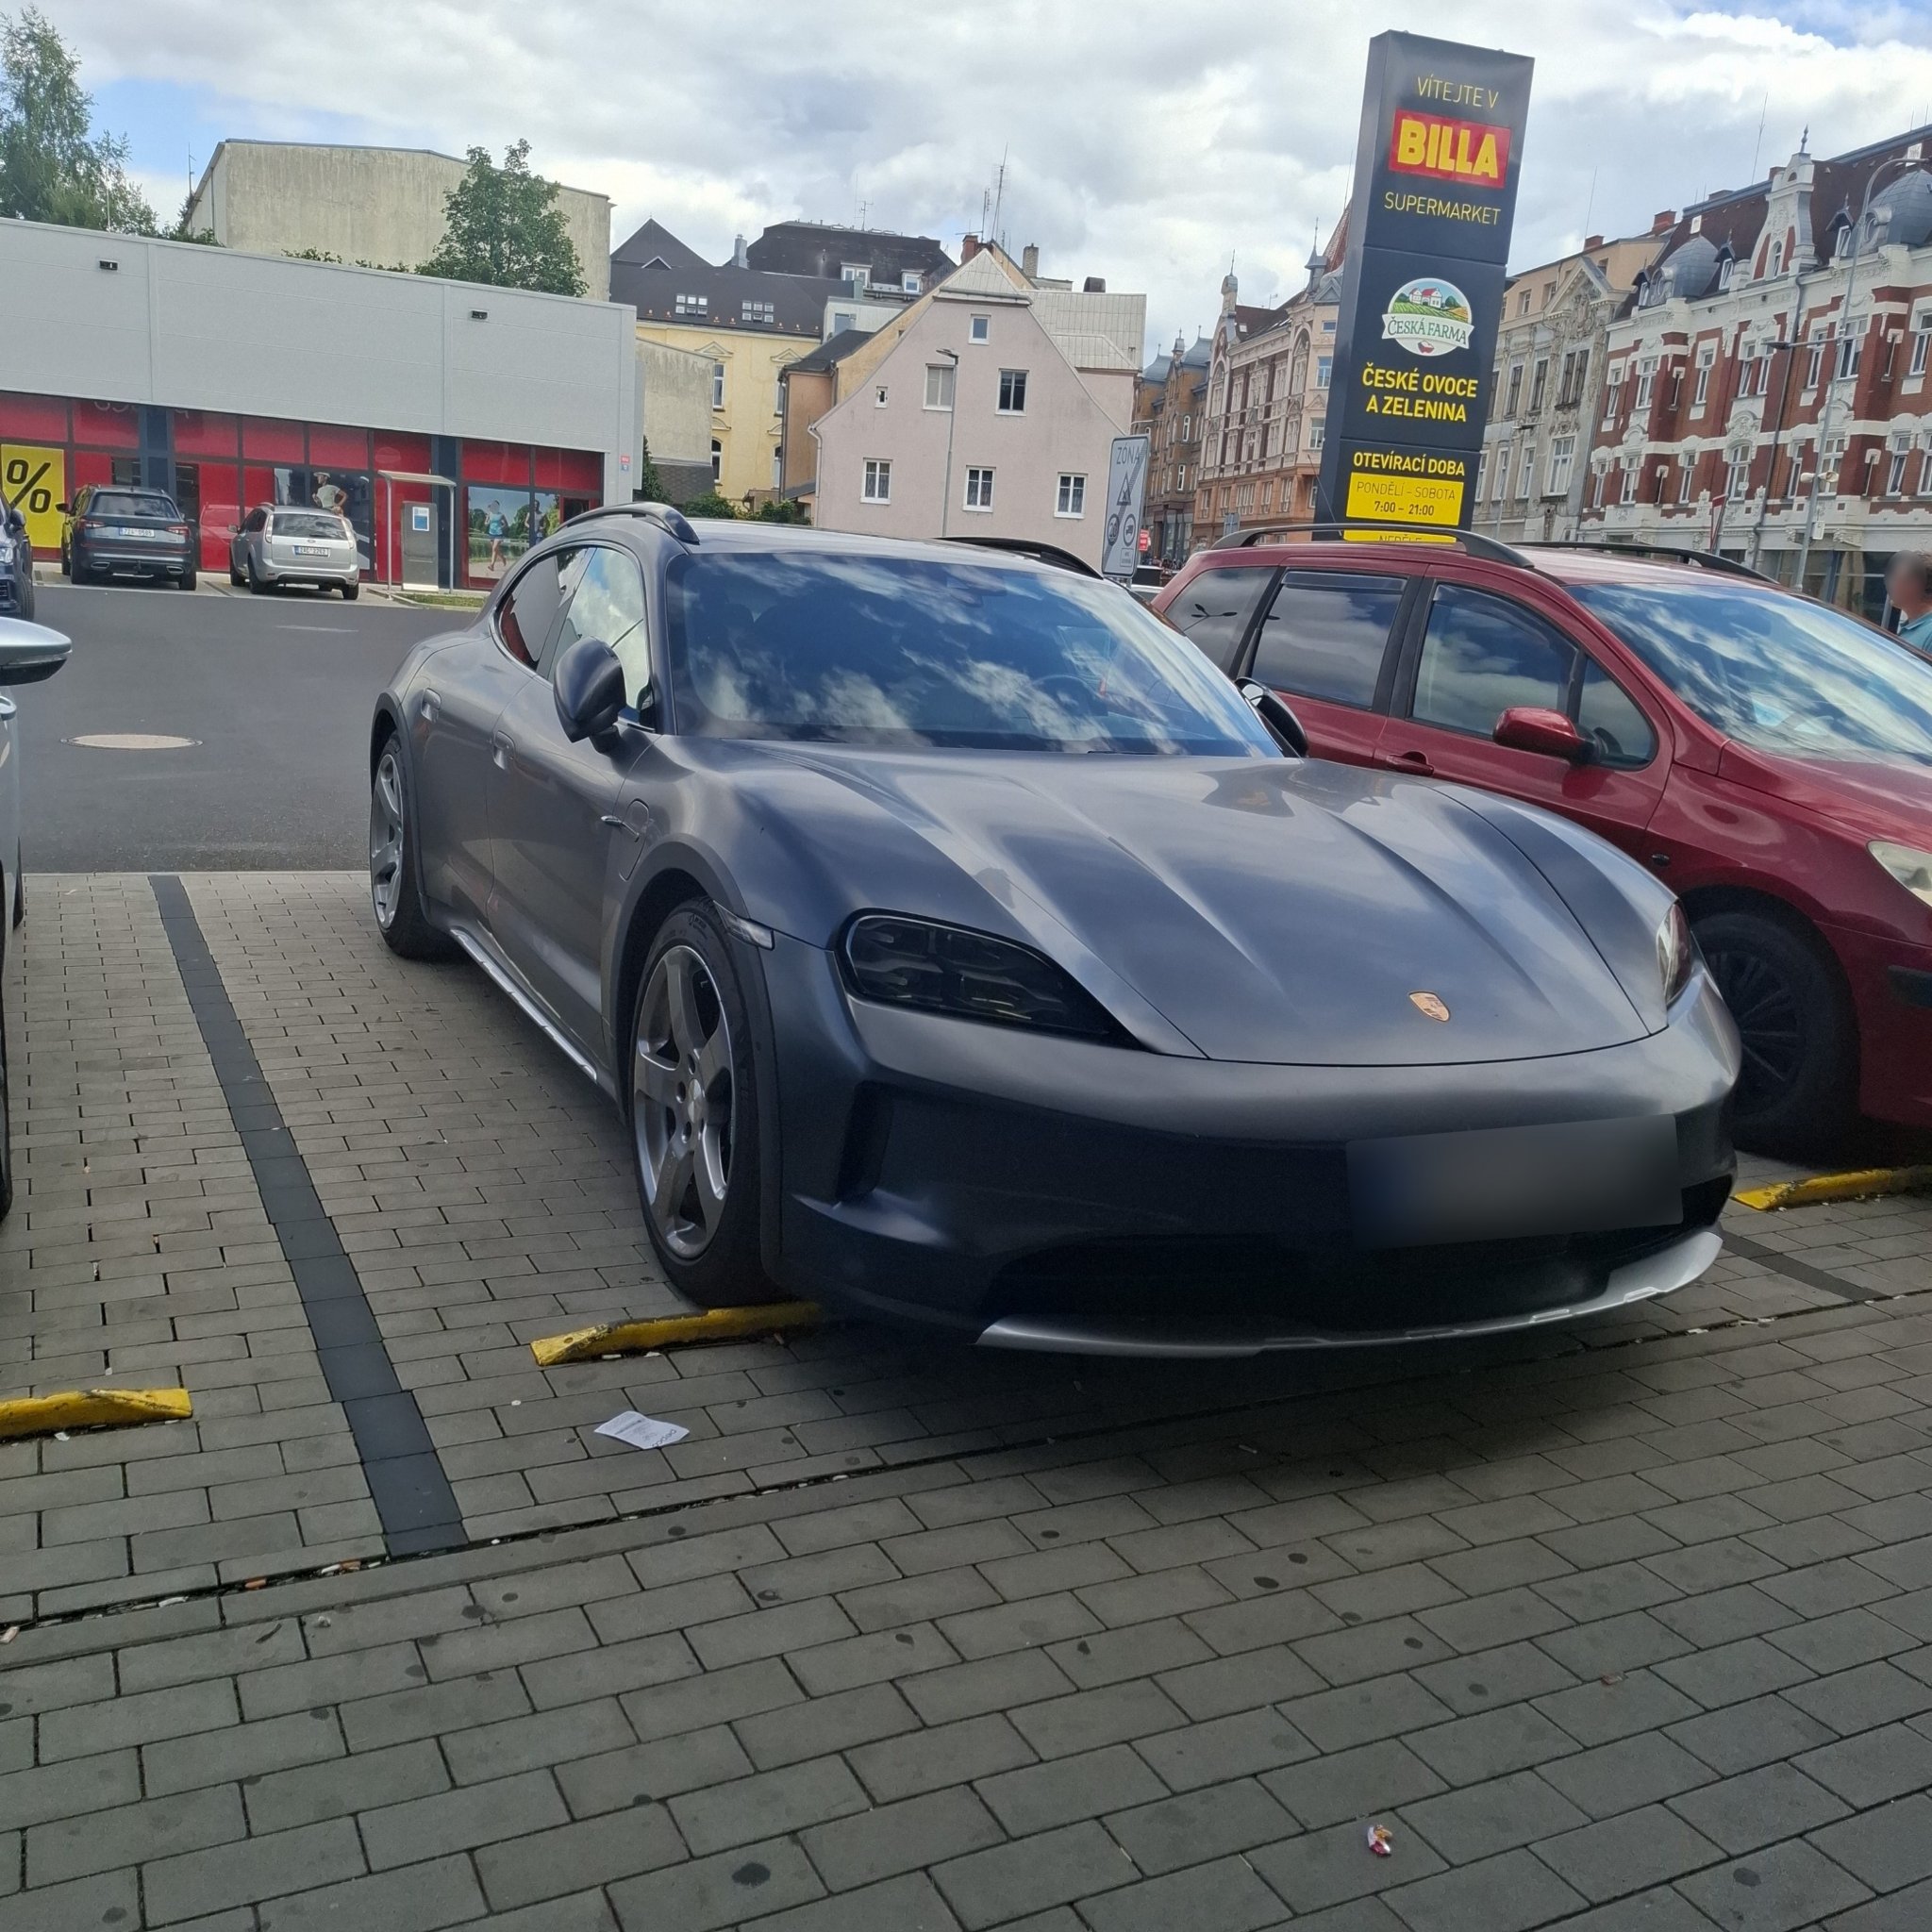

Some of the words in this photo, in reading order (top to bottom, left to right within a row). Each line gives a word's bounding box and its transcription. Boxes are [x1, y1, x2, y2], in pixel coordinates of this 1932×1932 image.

[1418, 74, 1484, 108] VÍTEJTE
[1488, 90, 1499, 108] V
[1397, 118, 1498, 179] BILLA
[1384, 192, 1501, 225] SUPERMARKET
[1387, 316, 1425, 336] ČESKÁ
[1427, 322, 1467, 345] FARMA
[1362, 361, 1420, 391] ČESKÉ
[1423, 375, 1478, 398] OVOCE
[1366, 394, 1378, 413] A
[1382, 395, 1466, 422] ZELENINA
[1116, 442, 1140, 465] ZÓNA
[1353, 450, 1426, 473] OTEVÍRACÍ
[1428, 458, 1465, 476] DOBA
[1357, 481, 1405, 496] PONDĚLÍ
[1414, 486, 1456, 501] SOBOTA
[1374, 501, 1396, 513] 7:00
[1408, 504, 1434, 516] 21:00
